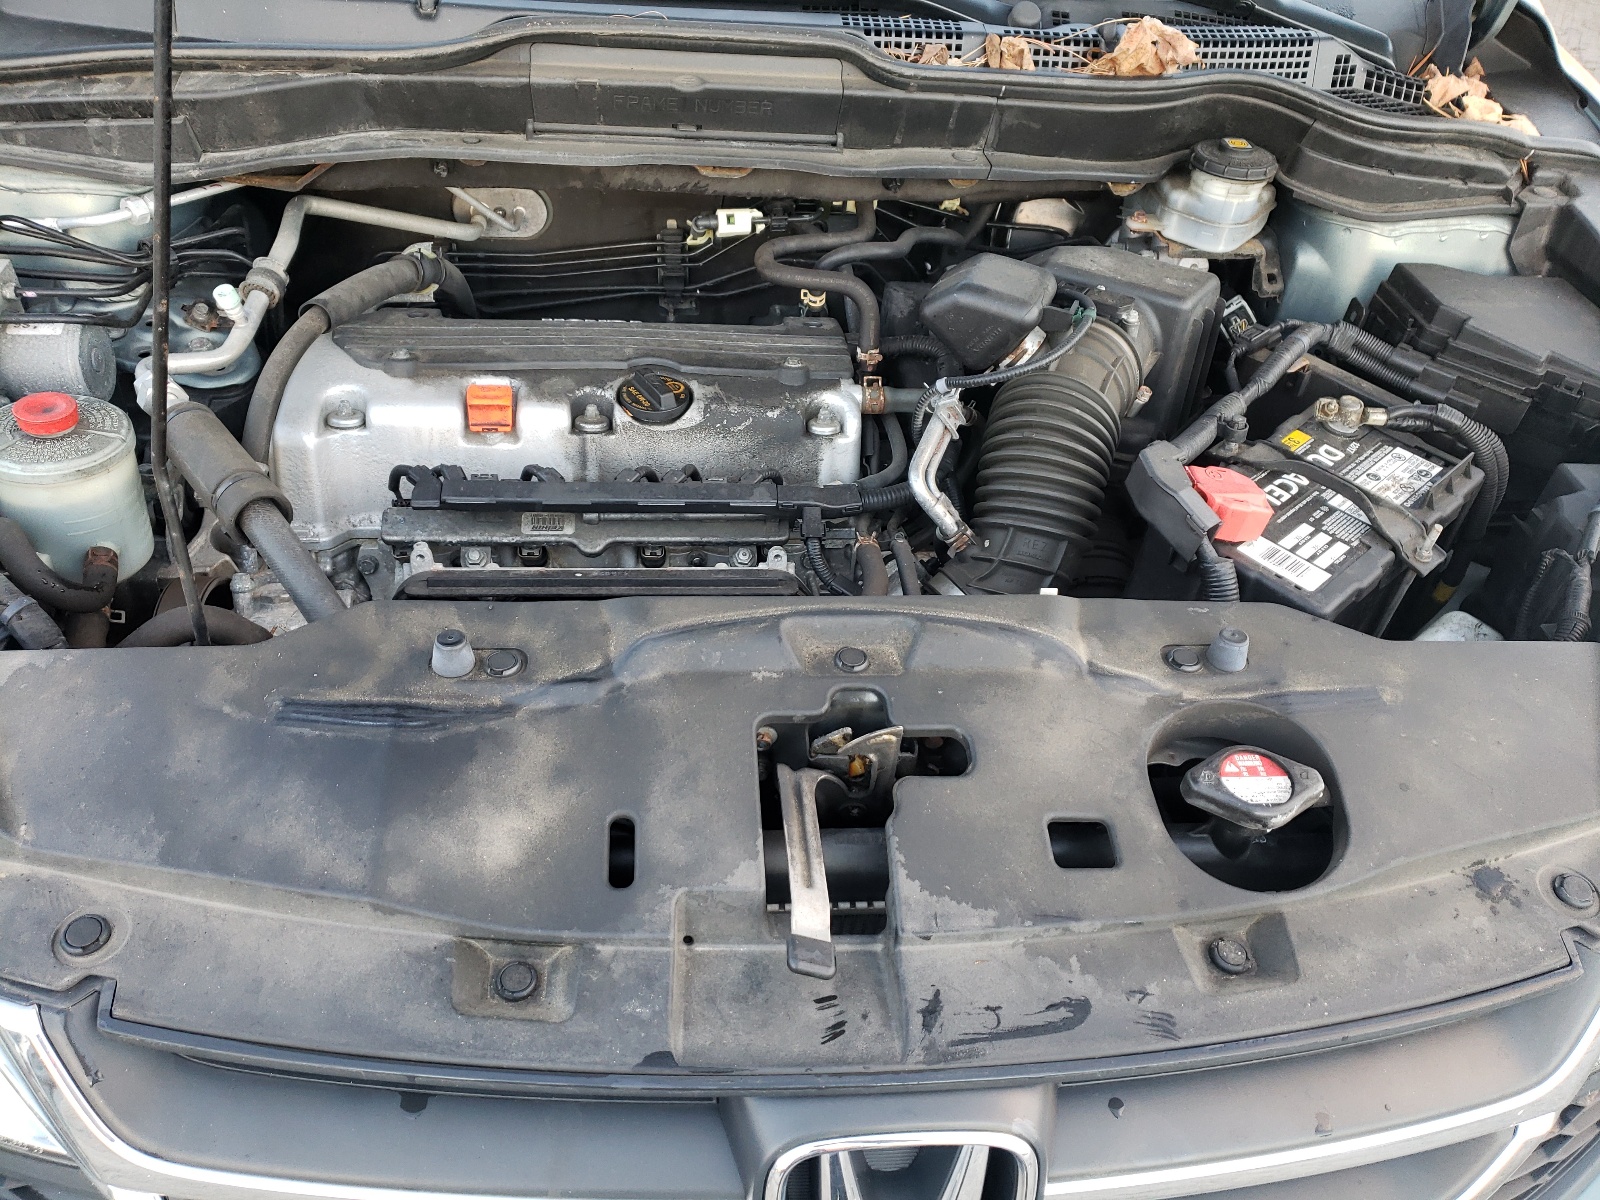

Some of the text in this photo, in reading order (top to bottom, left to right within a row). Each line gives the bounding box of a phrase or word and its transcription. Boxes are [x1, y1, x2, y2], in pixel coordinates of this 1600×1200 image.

[613, 95, 773, 117] FRAME NUMBER
[1265, 443, 1346, 507] DUACEL
